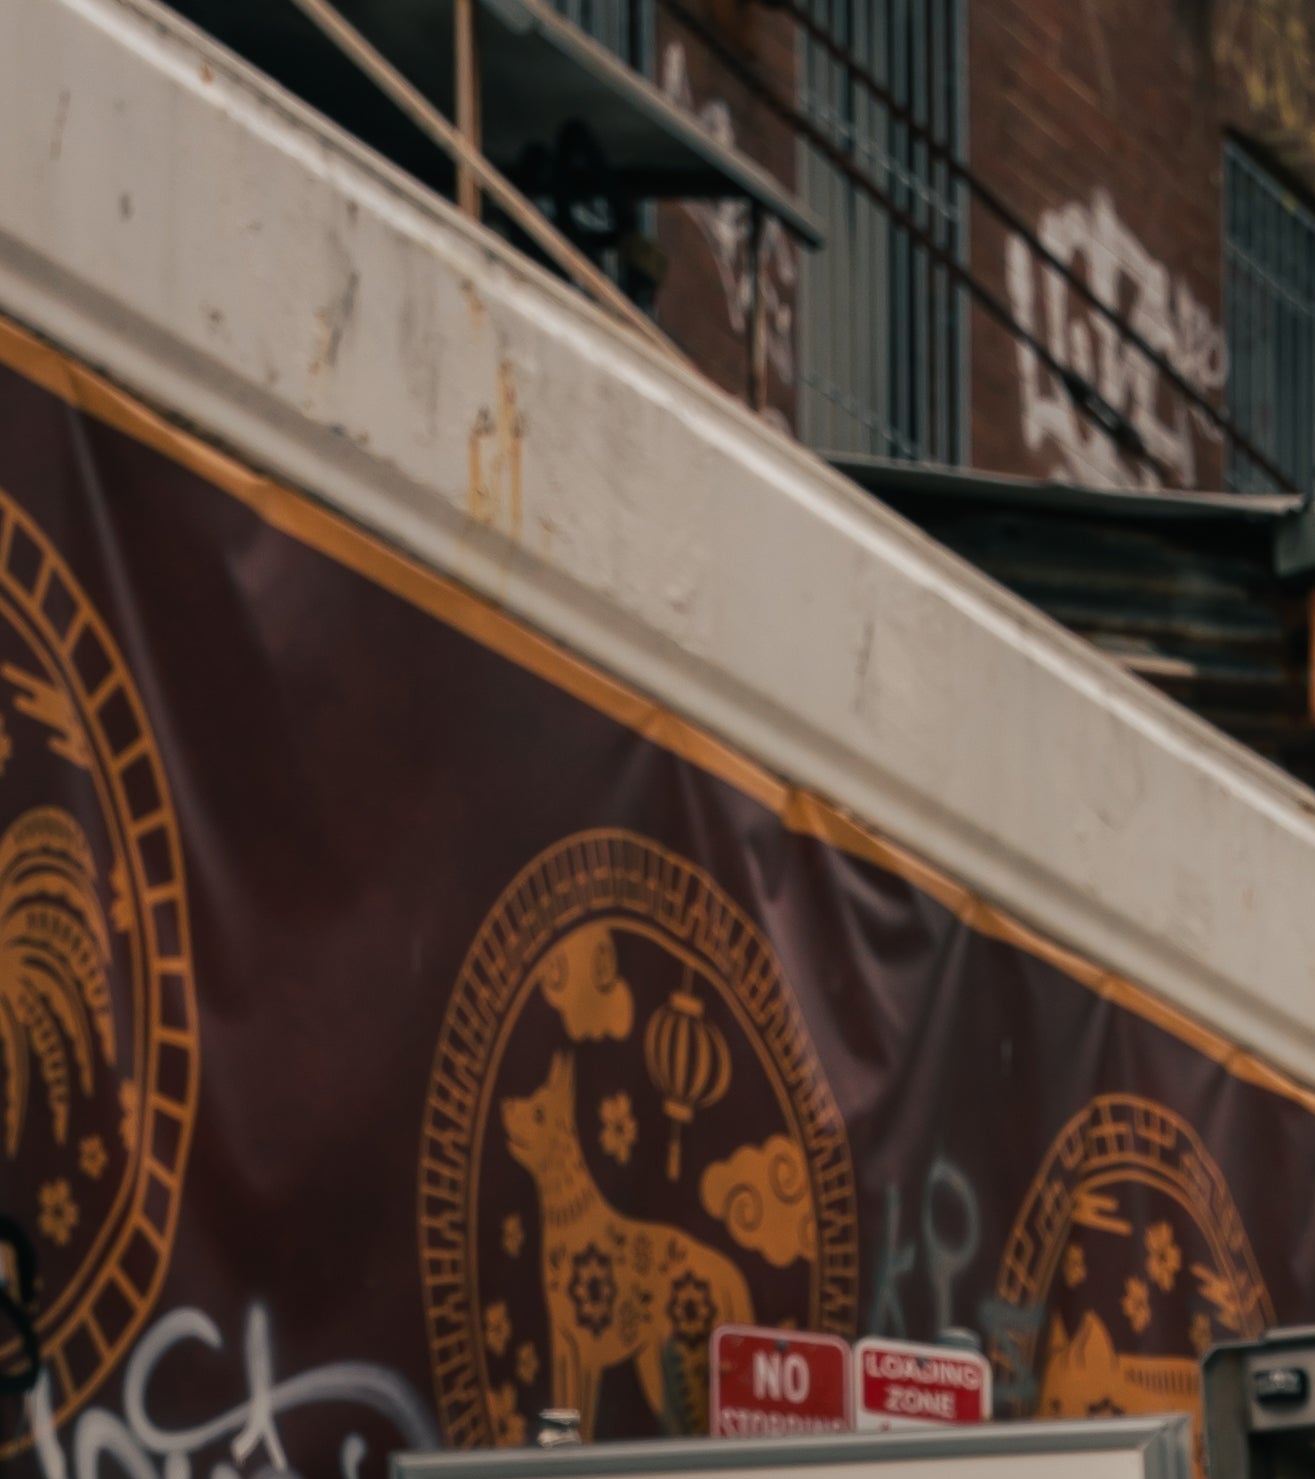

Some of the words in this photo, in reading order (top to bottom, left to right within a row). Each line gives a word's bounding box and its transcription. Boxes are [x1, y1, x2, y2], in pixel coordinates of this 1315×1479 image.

[752, 1350, 811, 1403] NO
[863, 1351, 983, 1391] LOADING
[883, 1384, 957, 1421] ZONE
